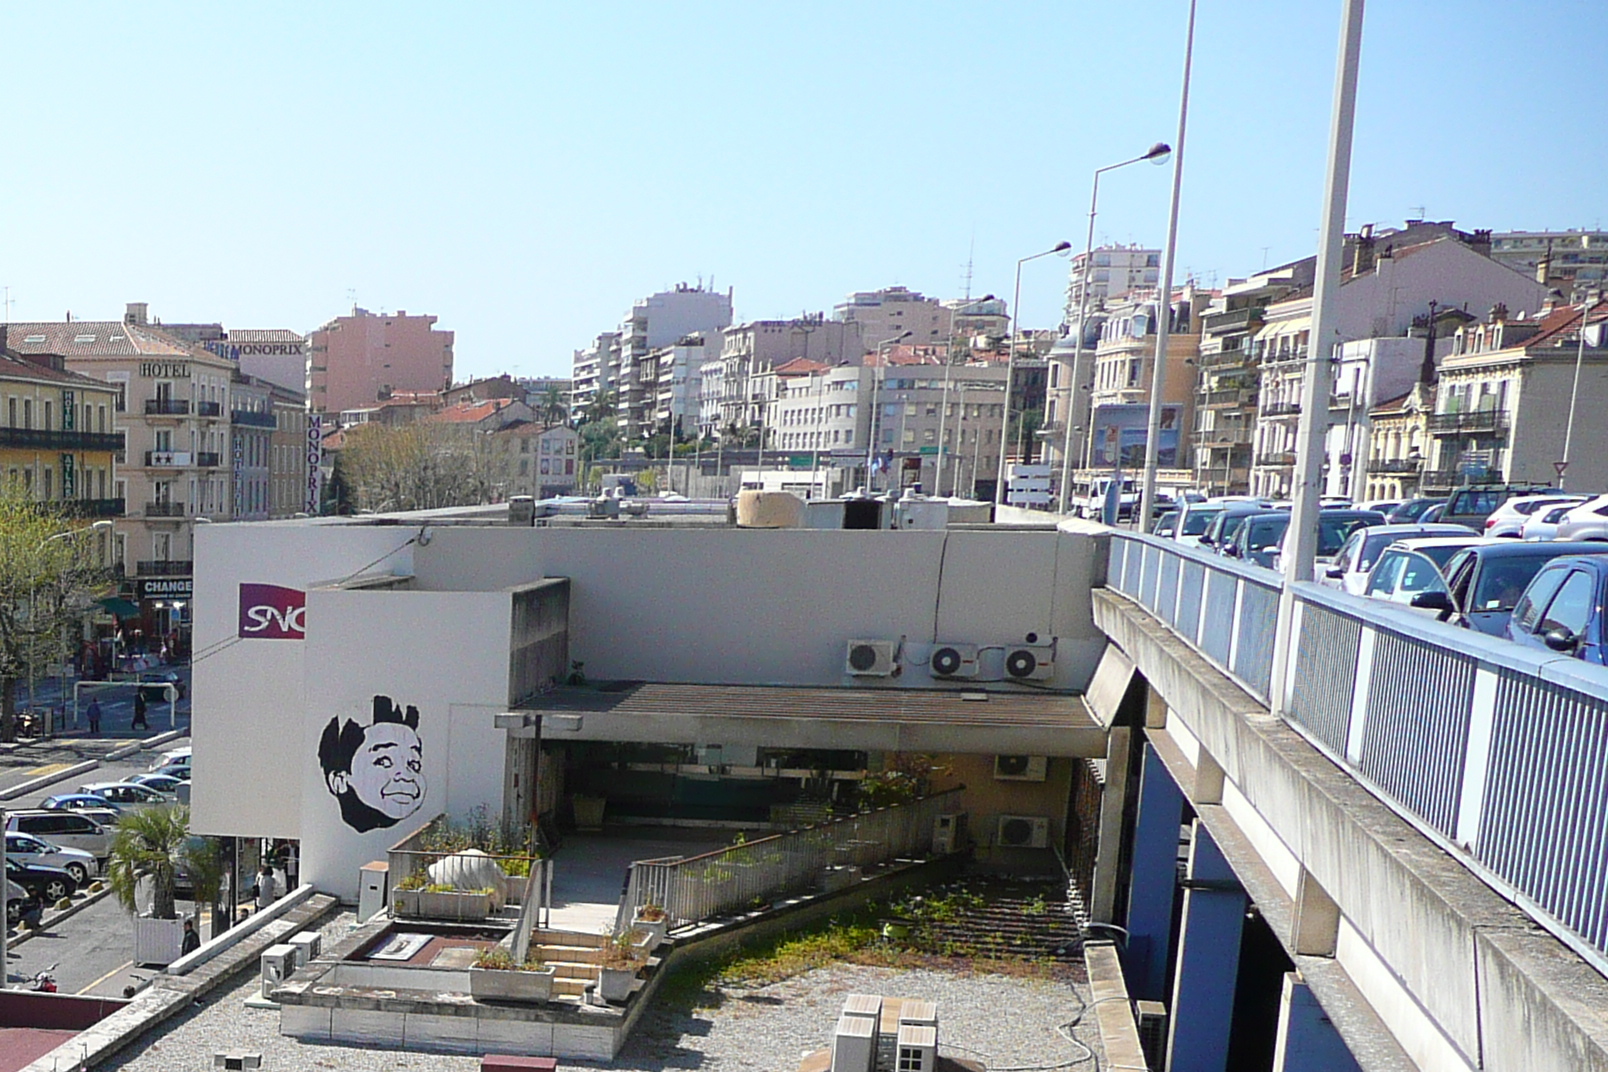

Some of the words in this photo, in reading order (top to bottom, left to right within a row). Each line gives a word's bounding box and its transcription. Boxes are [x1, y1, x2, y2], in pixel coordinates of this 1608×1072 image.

[142, 363, 191, 378] HOTEL
[64, 391, 73, 430] HOTEL
[64, 455, 73, 497] ATLAS
[306, 415, 321, 513] MONOPRIX
[144, 581, 192, 592] CHANGE
